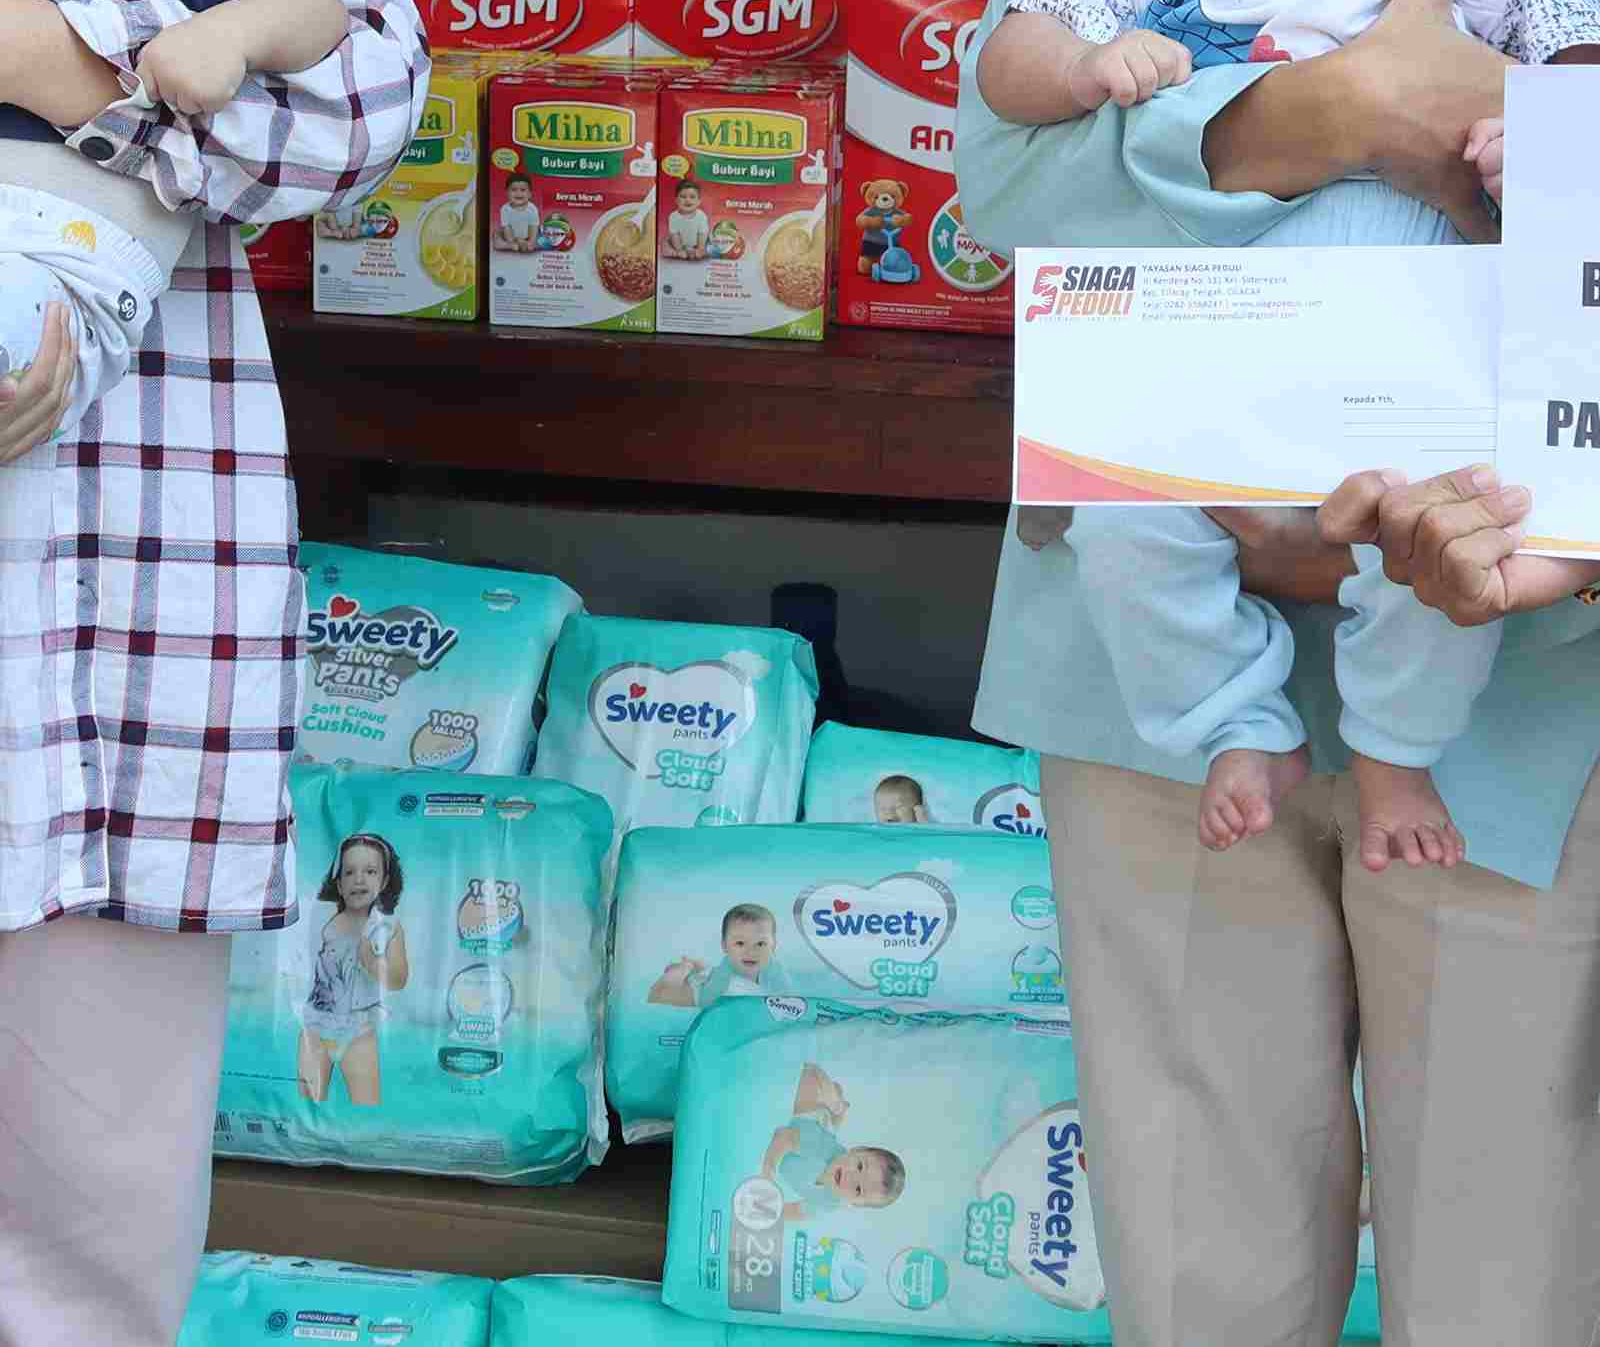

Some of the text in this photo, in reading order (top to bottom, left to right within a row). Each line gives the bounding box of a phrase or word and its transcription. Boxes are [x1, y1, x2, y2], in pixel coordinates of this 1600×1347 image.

[526, 111, 622, 143] Milna
[696, 117, 793, 151] Milna
[541, 155, 605, 171] Bubur Bayi
[712, 162, 776, 179] Bubur Bayi
[1062, 265, 1137, 292] SIAGA
[1142, 264, 1182, 272] YAYASAN
[1185, 264, 1210, 272] SIAGA
[1056, 292, 1134, 317] PEDULI
[1343, 394, 1376, 405] Kepada
[307, 613, 457, 671] Sweety
[336, 647, 394, 669] Silver
[316, 664, 401, 697] Pants
[311, 703, 388, 724] Soft Cloud
[429, 710, 479, 732] 1000
[606, 694, 736, 738] Sweety
[303, 716, 386, 742] Cushion
[673, 727, 709, 741] pants
[657, 750, 726, 775] Cloud
[662, 768, 714, 791] Soft
[812, 908, 941, 945] Sweety
[883, 936, 918, 948] pants
[870, 958, 937, 980] Cloud
[879, 976, 929, 997] Soft
[768, 997, 803, 1016] Sweety
[1030, 1121, 1083, 1289] Sweety
[963, 1200, 993, 1266] Soft
[986, 1191, 1015, 1279] Cloud
[1027, 1211, 1042, 1255] pants
[745, 1233, 775, 1279] 28
